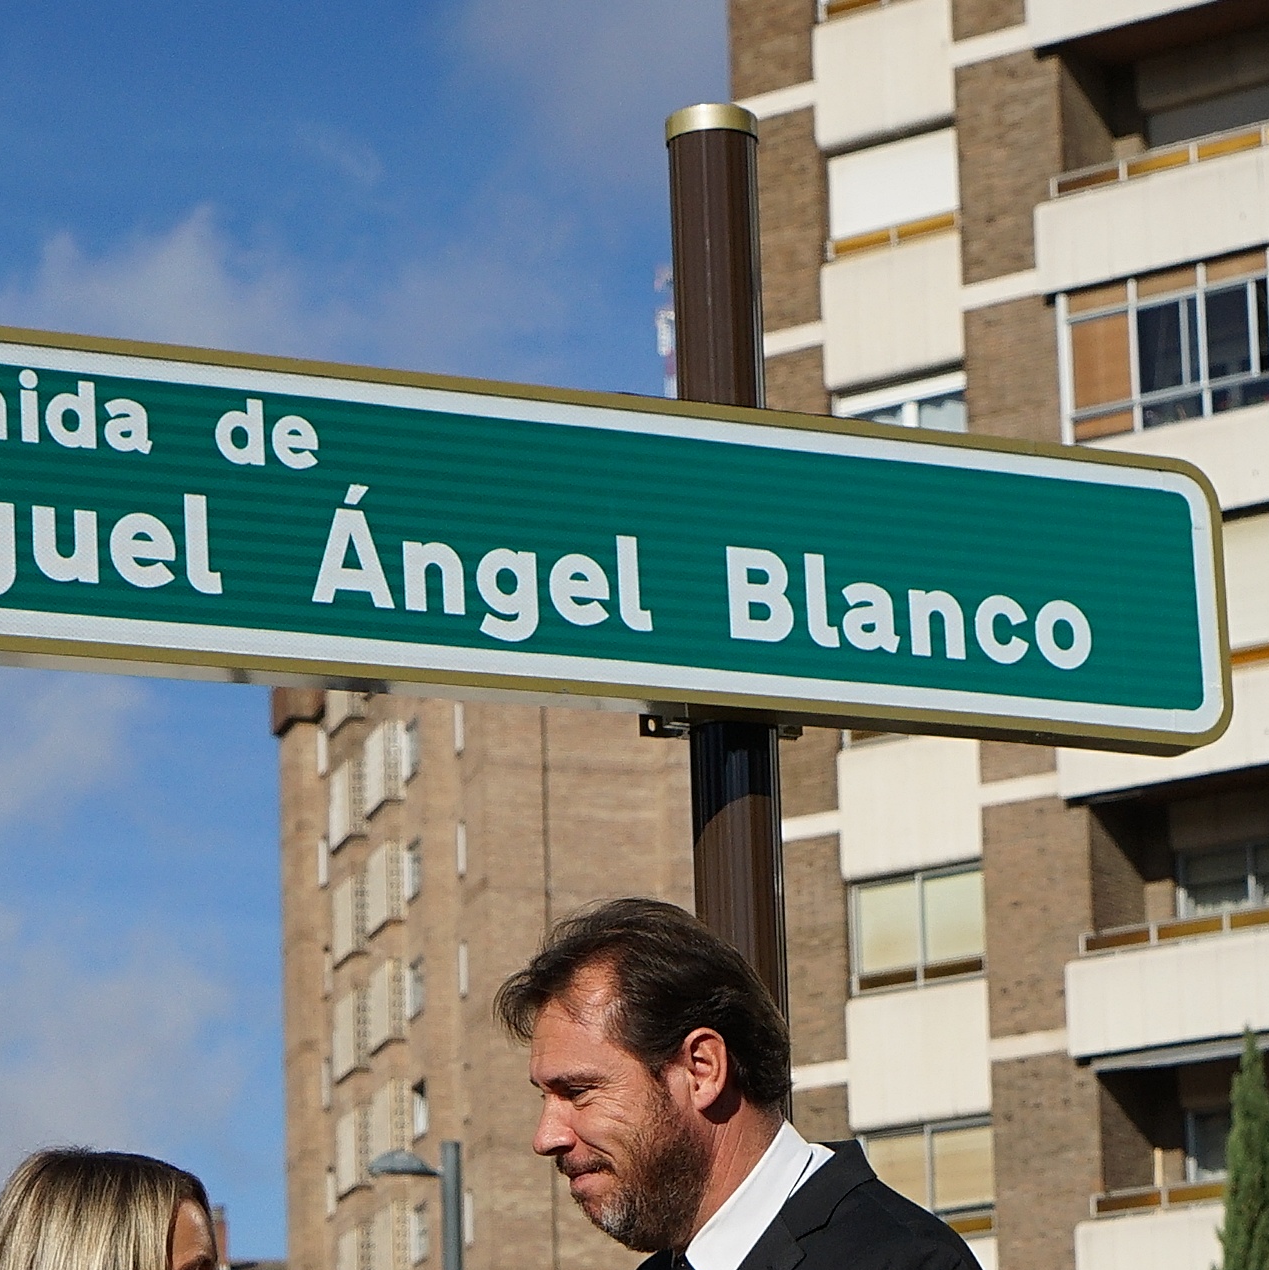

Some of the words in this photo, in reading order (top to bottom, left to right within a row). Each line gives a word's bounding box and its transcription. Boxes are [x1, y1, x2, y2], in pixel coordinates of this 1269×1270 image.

[215, 398, 320, 470] de
[311, 484, 653, 643] Ángel
[725, 545, 1092, 670] Blanco
